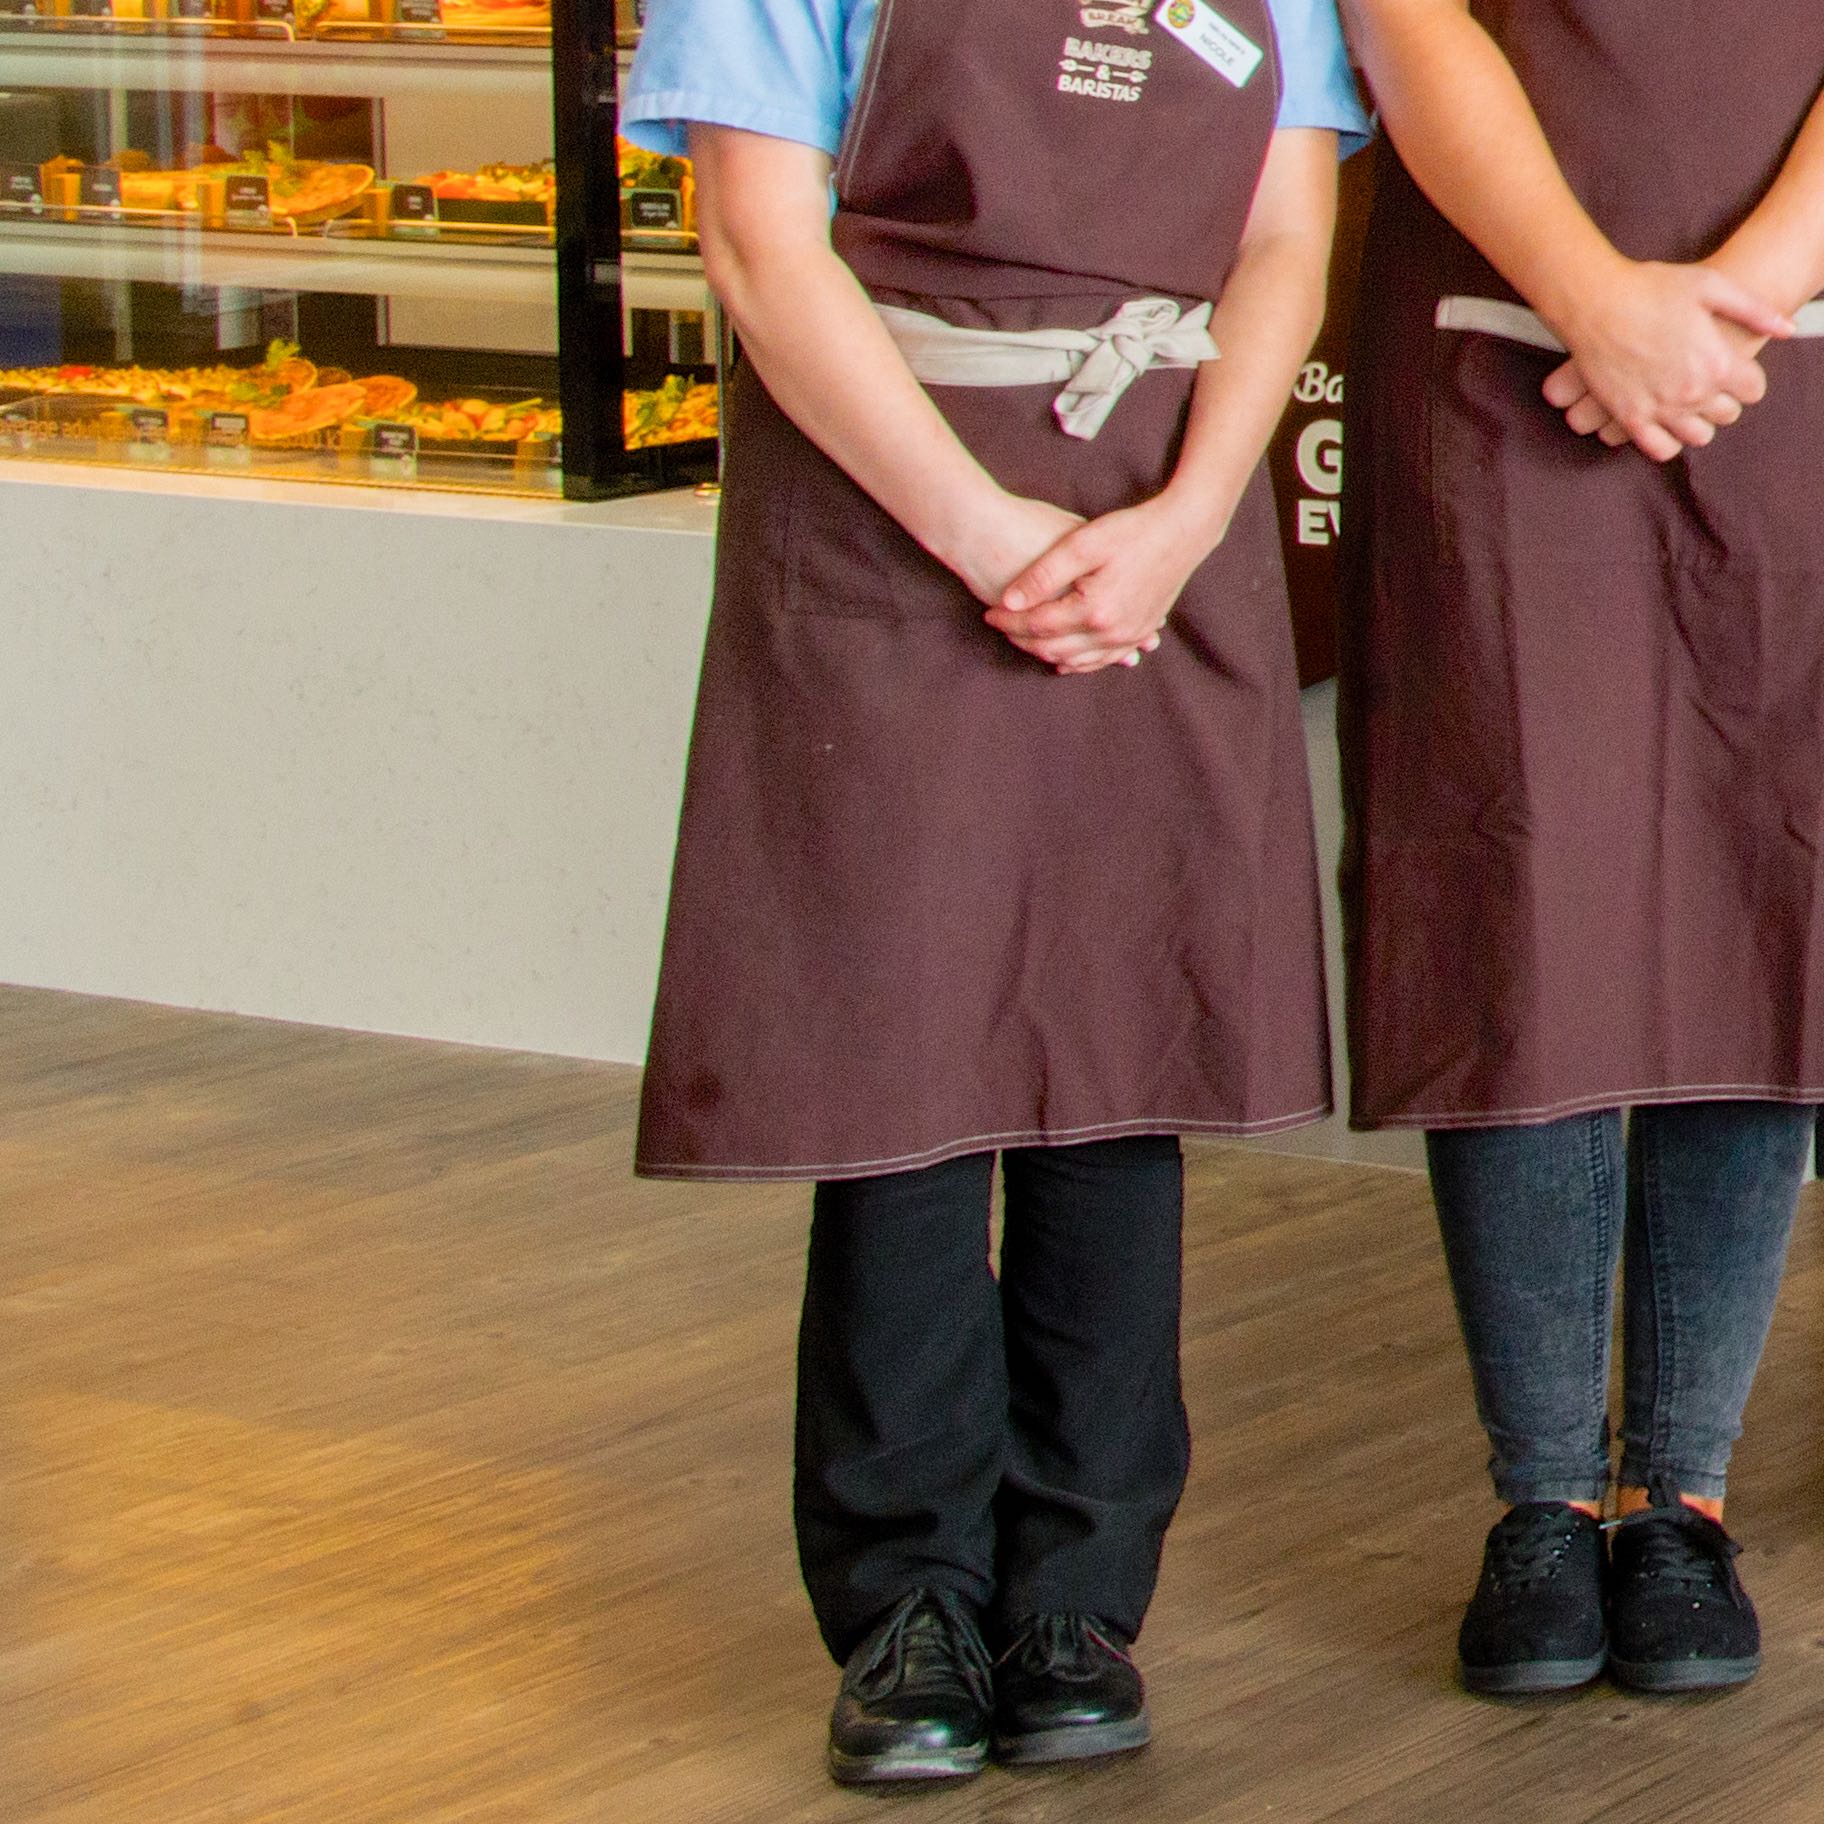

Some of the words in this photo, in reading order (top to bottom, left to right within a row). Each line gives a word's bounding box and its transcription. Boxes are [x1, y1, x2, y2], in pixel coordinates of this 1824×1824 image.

[1064, 37, 1152, 69] BAKERS
[1096, 65, 1111, 81] &
[1057, 75, 1142, 101] BARISTAS
